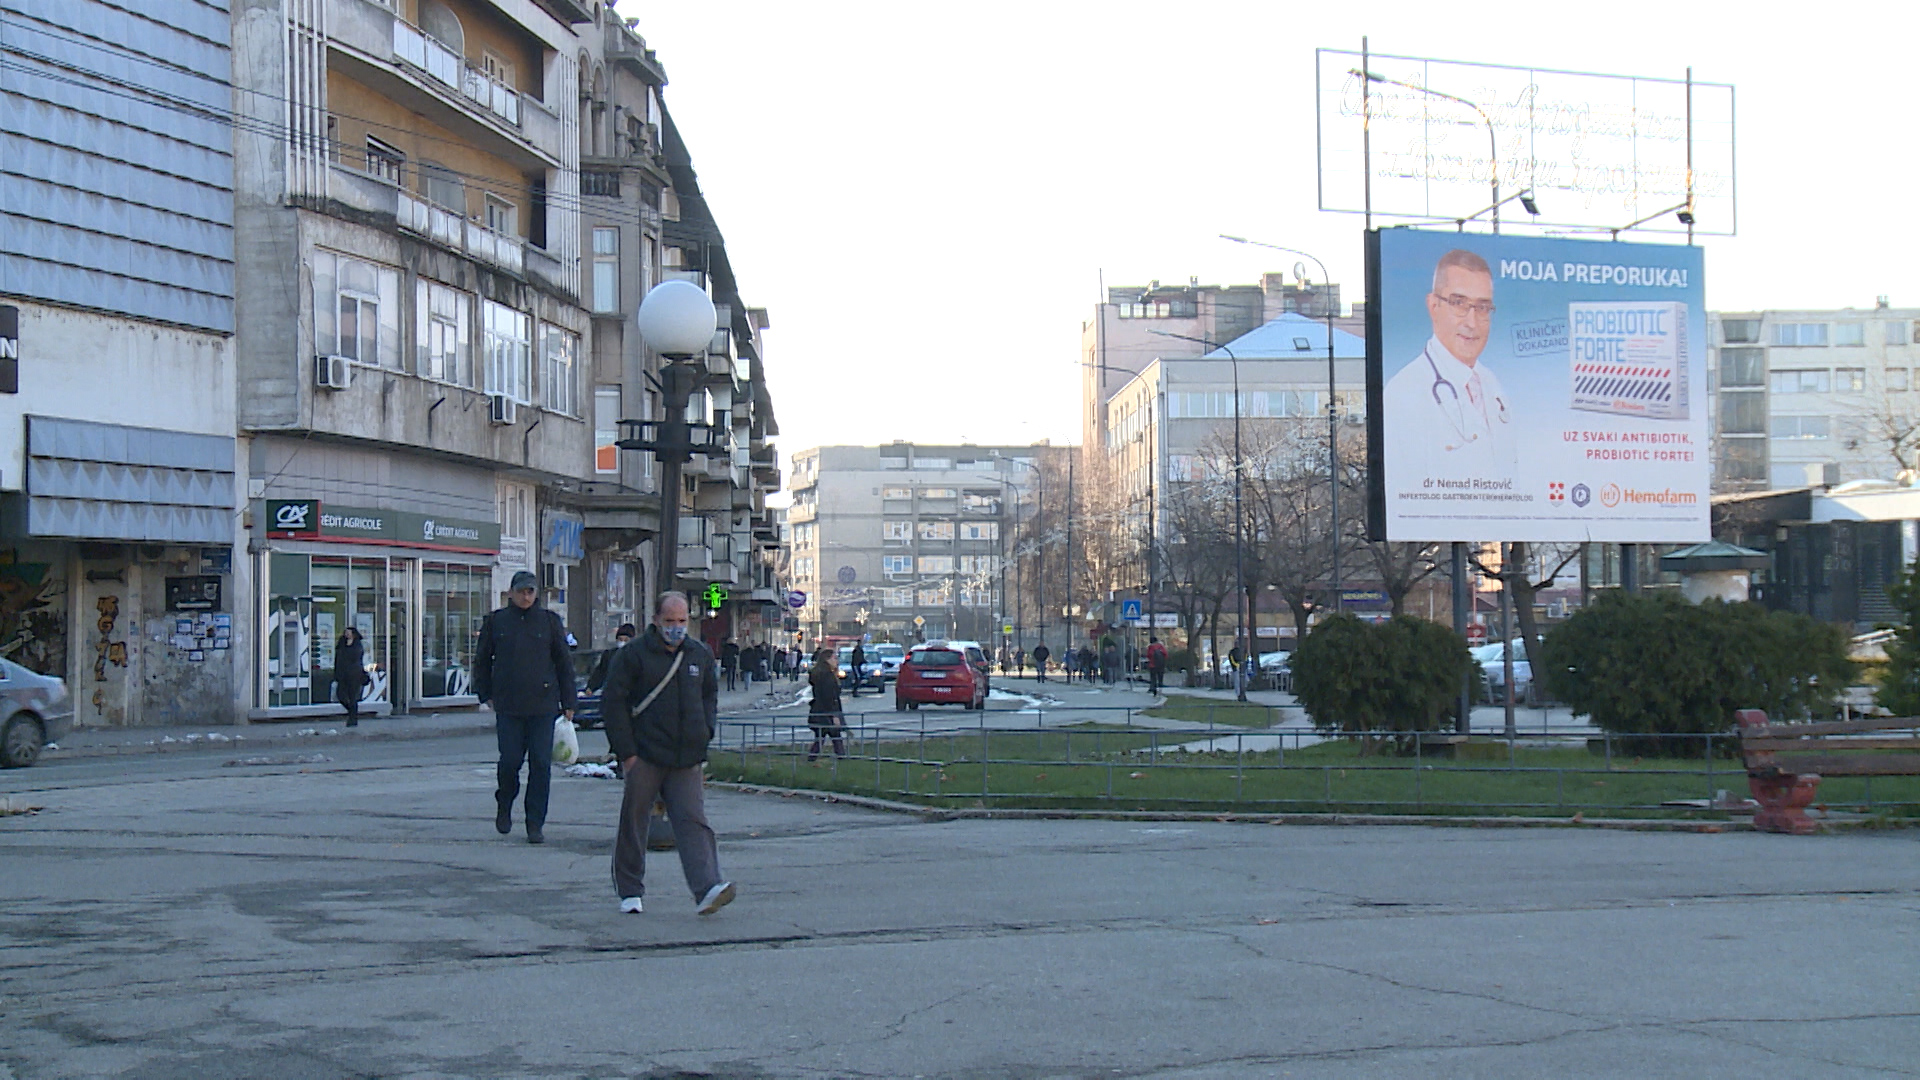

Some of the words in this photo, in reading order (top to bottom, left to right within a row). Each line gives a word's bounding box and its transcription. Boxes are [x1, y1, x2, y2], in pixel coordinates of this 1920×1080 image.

[1500, 259, 1558, 282] MOJA
[1563, 262, 1688, 288] PREPORUKA!
[1575, 309, 1671, 335] PROBIOTIC
[1518, 337, 1569, 352] DOKAZANO
[1574, 337, 1626, 362] FORTE
[1563, 431, 1579, 442] UZ
[1582, 431, 1618, 442] SVAKI
[1621, 432, 1694, 446] ANTIBIOTIK,
[1586, 449, 1650, 460] PROBIOTIC
[1654, 451, 1694, 462] FORTE!
[1423, 478, 1434, 488] dr
[1437, 478, 1471, 488] Nenad
[1473, 477, 1513, 490] Ristović
[1623, 488, 1697, 504] Hemofarm
[343, 516, 382, 531] AGRICOLE
[454, 527, 479, 540] AGRICOLE
